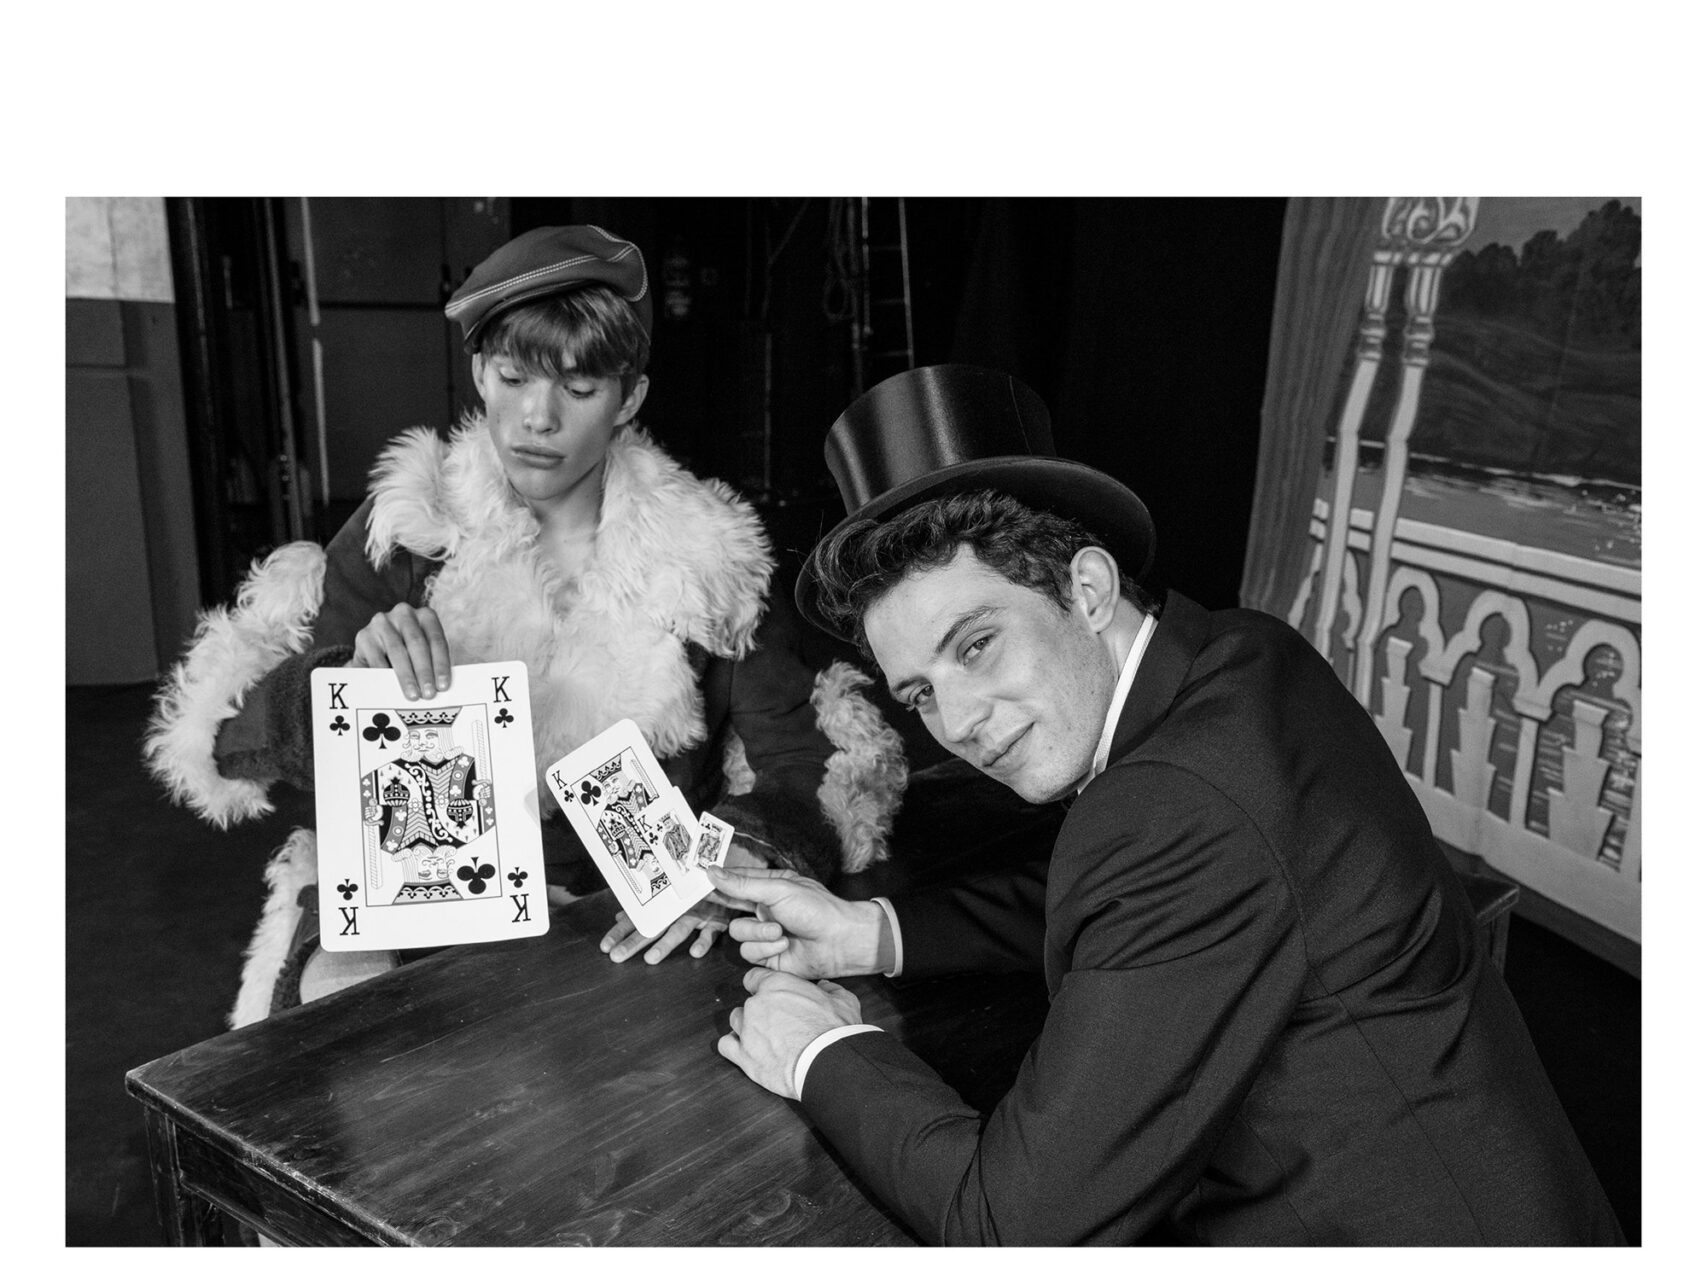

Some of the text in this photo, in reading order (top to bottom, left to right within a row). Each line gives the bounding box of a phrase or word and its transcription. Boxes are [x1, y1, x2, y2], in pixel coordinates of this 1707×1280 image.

[328, 682, 348, 709] K
[491, 675, 511, 702] K
[551, 769, 568, 790] K
[637, 814, 653, 833] K
[339, 907, 360, 936] K
[510, 893, 531, 923] K
